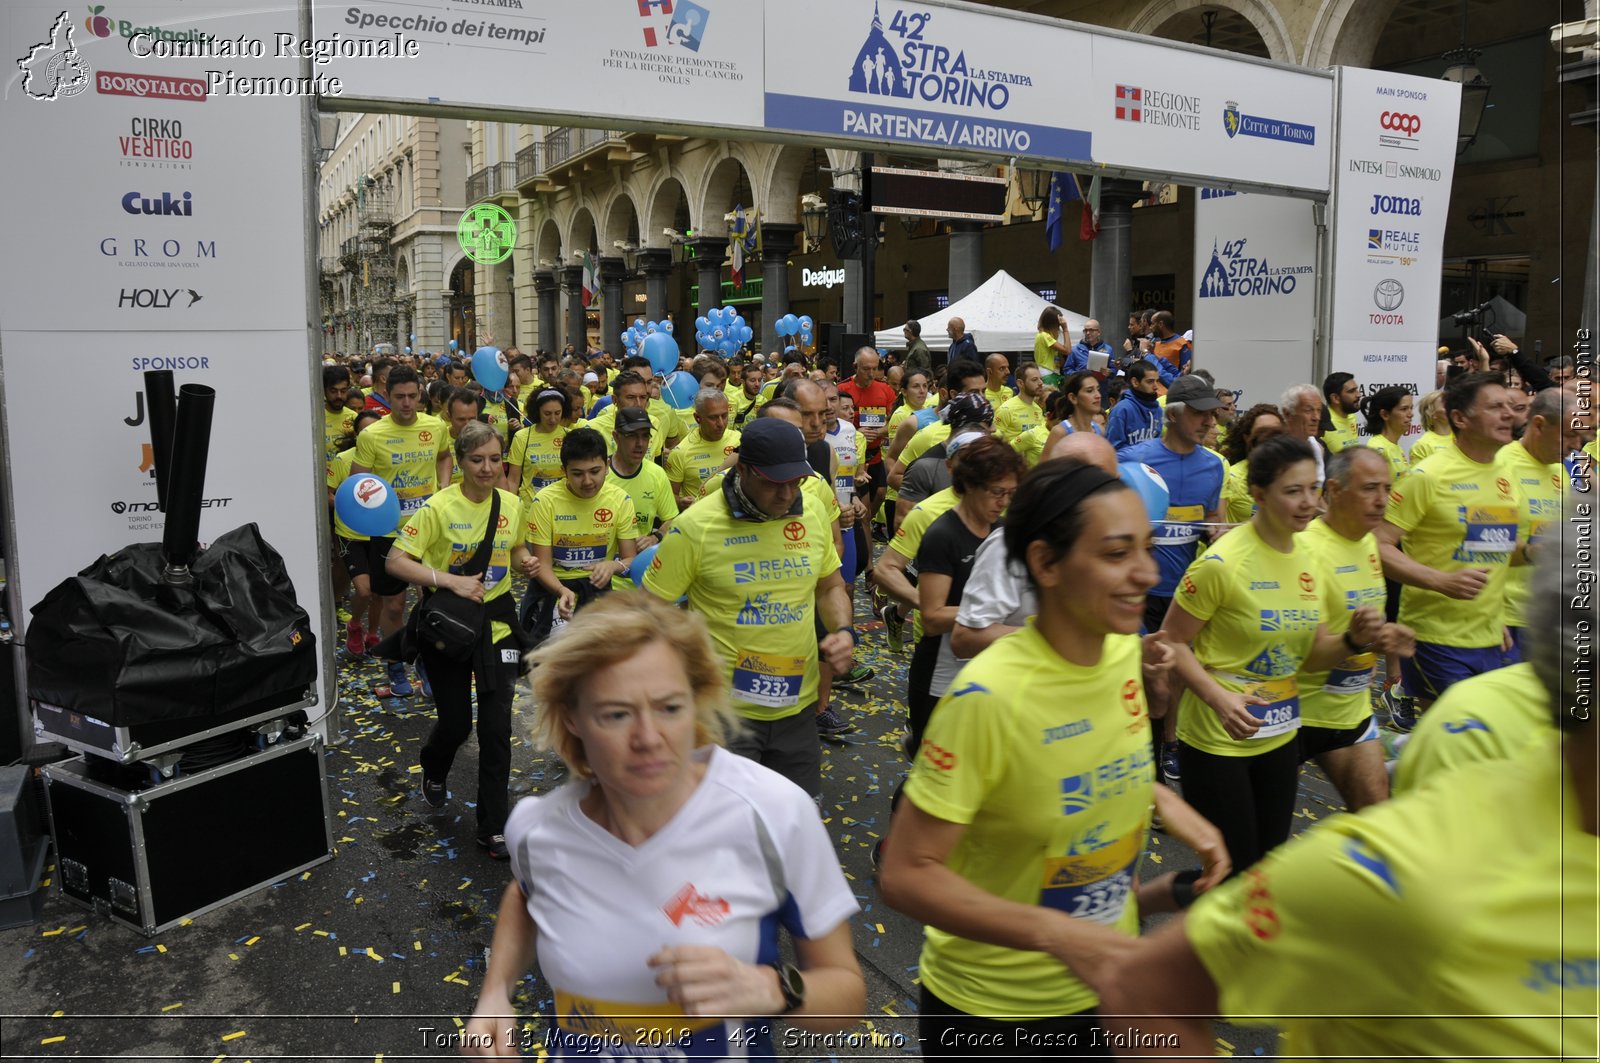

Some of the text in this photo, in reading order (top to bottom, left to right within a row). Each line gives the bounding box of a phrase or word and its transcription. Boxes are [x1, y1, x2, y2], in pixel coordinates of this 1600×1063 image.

[344, 7, 546, 46] Specchio dei tempi
[889, 9, 931, 41] 42°
[602, 58, 744, 81] PER LA RICERCA SUL CANCRO
[610, 49, 737, 71] FONDAZIONE PIEMONTESE
[901, 41, 1033, 87] STRA LA STAMPA
[99, 75, 204, 97] BOROTALCO
[658, 75, 691, 85] ONLUS
[906, 70, 1009, 110] TORINO
[1143, 89, 1200, 114] REGIONE
[1376, 86, 1427, 101] MAIN SPONSOR
[131, 117, 182, 139] CIRKO
[1143, 108, 1200, 131] PIEMONTE
[1380, 111, 1421, 137] coop
[843, 109, 1031, 151] PARTENZA/ARRIVO
[1271, 126, 1280, 136] DI
[1283, 124, 1313, 141] TORINO
[119, 136, 192, 159] VERTIGO
[119, 161, 192, 170] FONDAZIONE
[1349, 159, 1441, 181] INTESA SANPAOLO
[121, 191, 192, 217] Cuki
[1385, 230, 1420, 243] REALE
[1222, 238, 1247, 259] 42°
[1384, 242, 1419, 252] MUTUA
[802, 265, 845, 289] Desigua
[1228, 258, 1269, 278] STRA
[1281, 265, 1313, 275] STAMPA
[1230, 275, 1296, 296] TORINO
[118, 288, 180, 308] HOLY
[1369, 314, 1404, 325] TOYOTA
[132, 356, 209, 370] SPONSOR
[1363, 354, 1408, 362] MEDIA PARTNER
[405, 449, 433, 459] REALE
[565, 550, 595, 561] 3114
[783, 541, 811, 551] TOYOTA
[759, 556, 811, 572] REALE
[760, 568, 813, 581] MUTUA
[760, 602, 790, 614] STRA
[762, 610, 803, 625] TORINO
[749, 678, 790, 697] 3232
[1263, 705, 1293, 726] 4268
